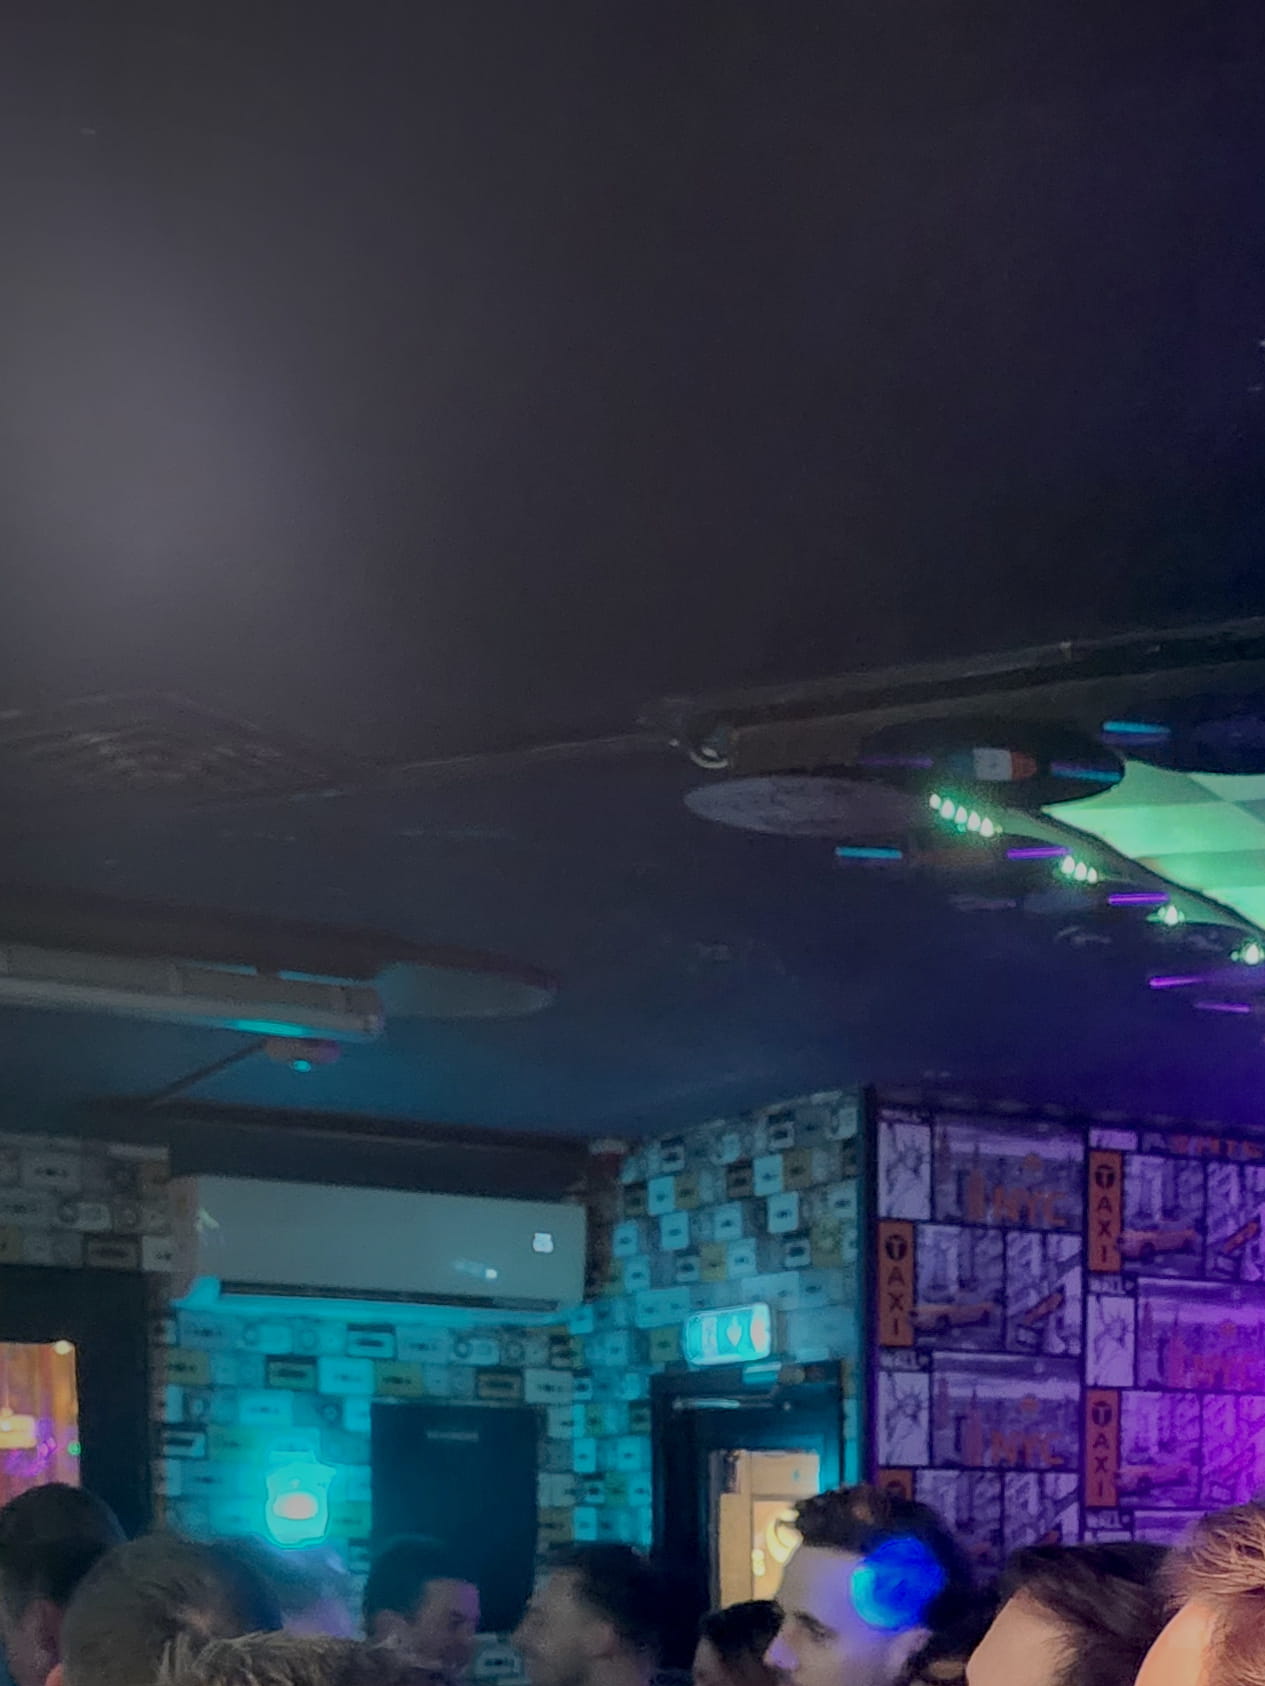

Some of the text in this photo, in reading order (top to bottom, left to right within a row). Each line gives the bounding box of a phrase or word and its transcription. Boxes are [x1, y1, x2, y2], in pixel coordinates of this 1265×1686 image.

[1094, 1165, 1115, 1263] TAXI
[885, 1234, 908, 1336] TAXI
[1091, 1401, 1113, 1497] TAXI
